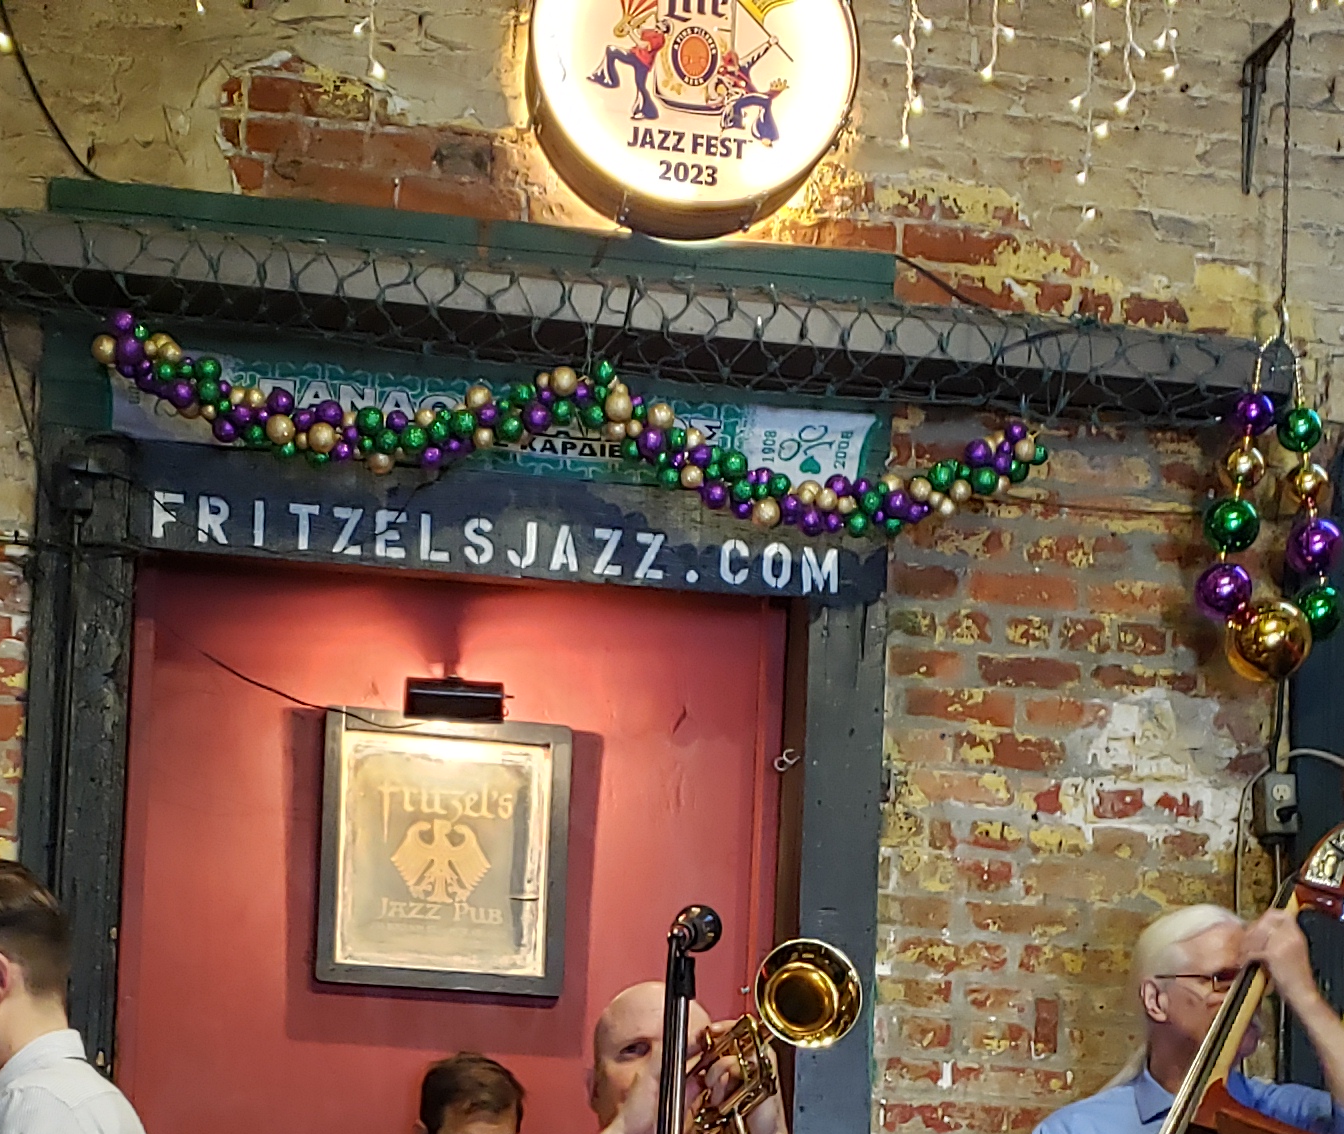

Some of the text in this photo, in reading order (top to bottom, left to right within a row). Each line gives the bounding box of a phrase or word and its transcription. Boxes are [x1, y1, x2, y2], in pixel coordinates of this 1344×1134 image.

[627, 125, 747, 160] JAZZ FEST
[658, 159, 719, 187] 2023
[522, 435, 624, 459] ΚΑΡΔΙΕ
[761, 429, 778, 463] 1908
[833, 430, 854, 470] 2008
[148, 489, 841, 596] FRITZELSJAZZ.COM
